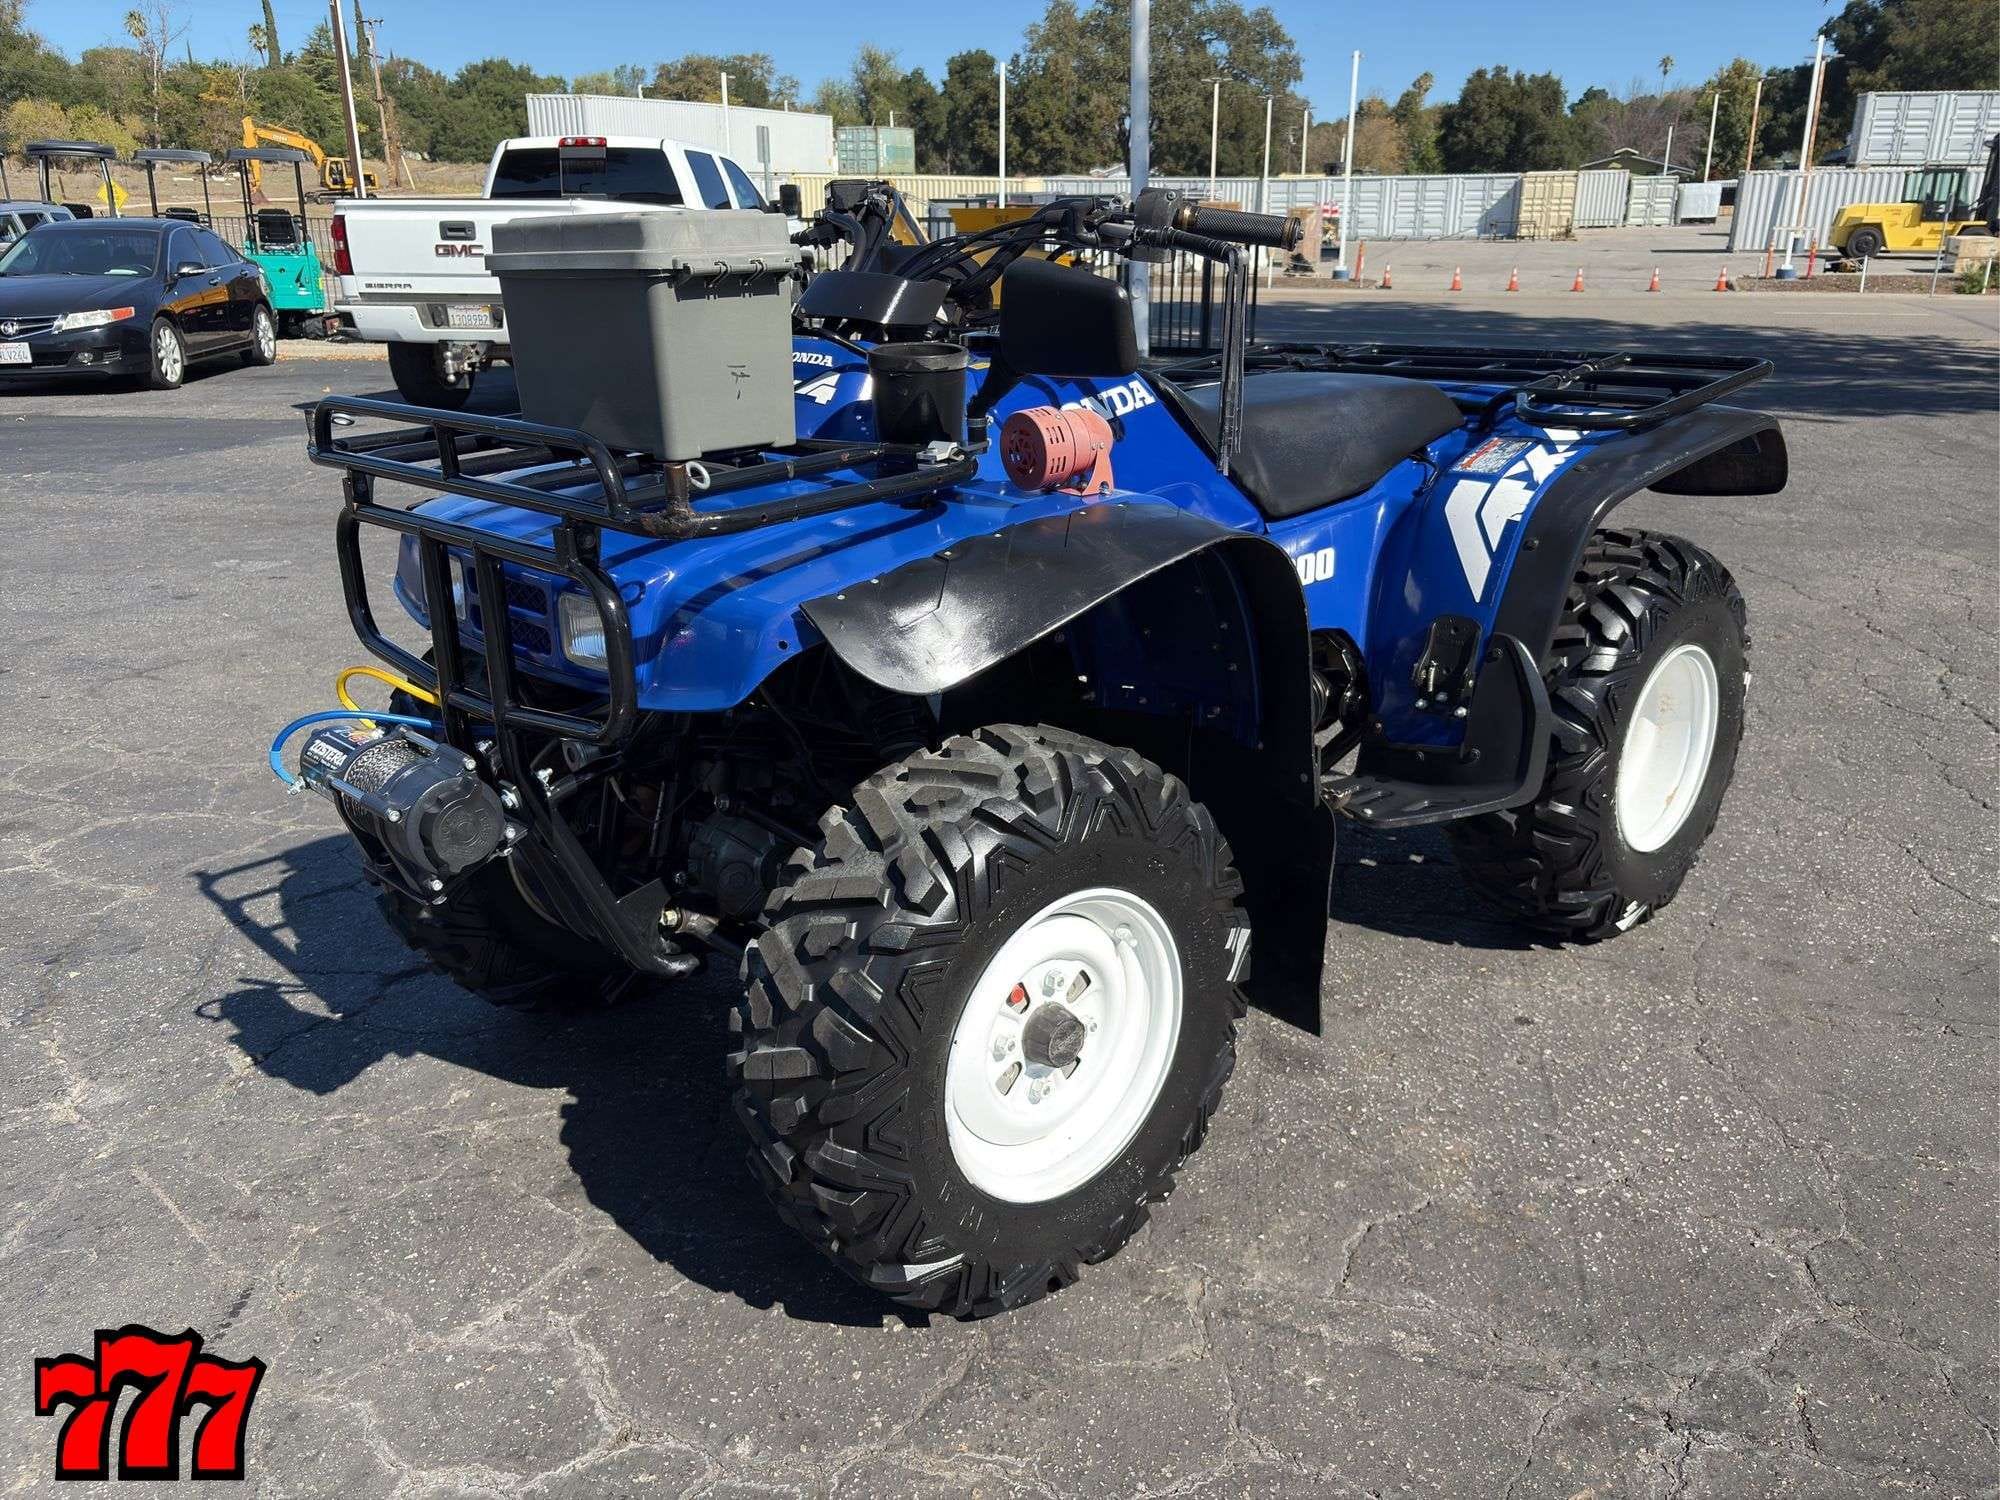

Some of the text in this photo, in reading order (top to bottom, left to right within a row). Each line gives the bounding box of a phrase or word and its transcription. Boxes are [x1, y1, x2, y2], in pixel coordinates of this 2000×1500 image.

[435, 244, 485, 257] GMC
[792, 352, 833, 368] ONDA
[1291, 547, 1336, 586] 00
